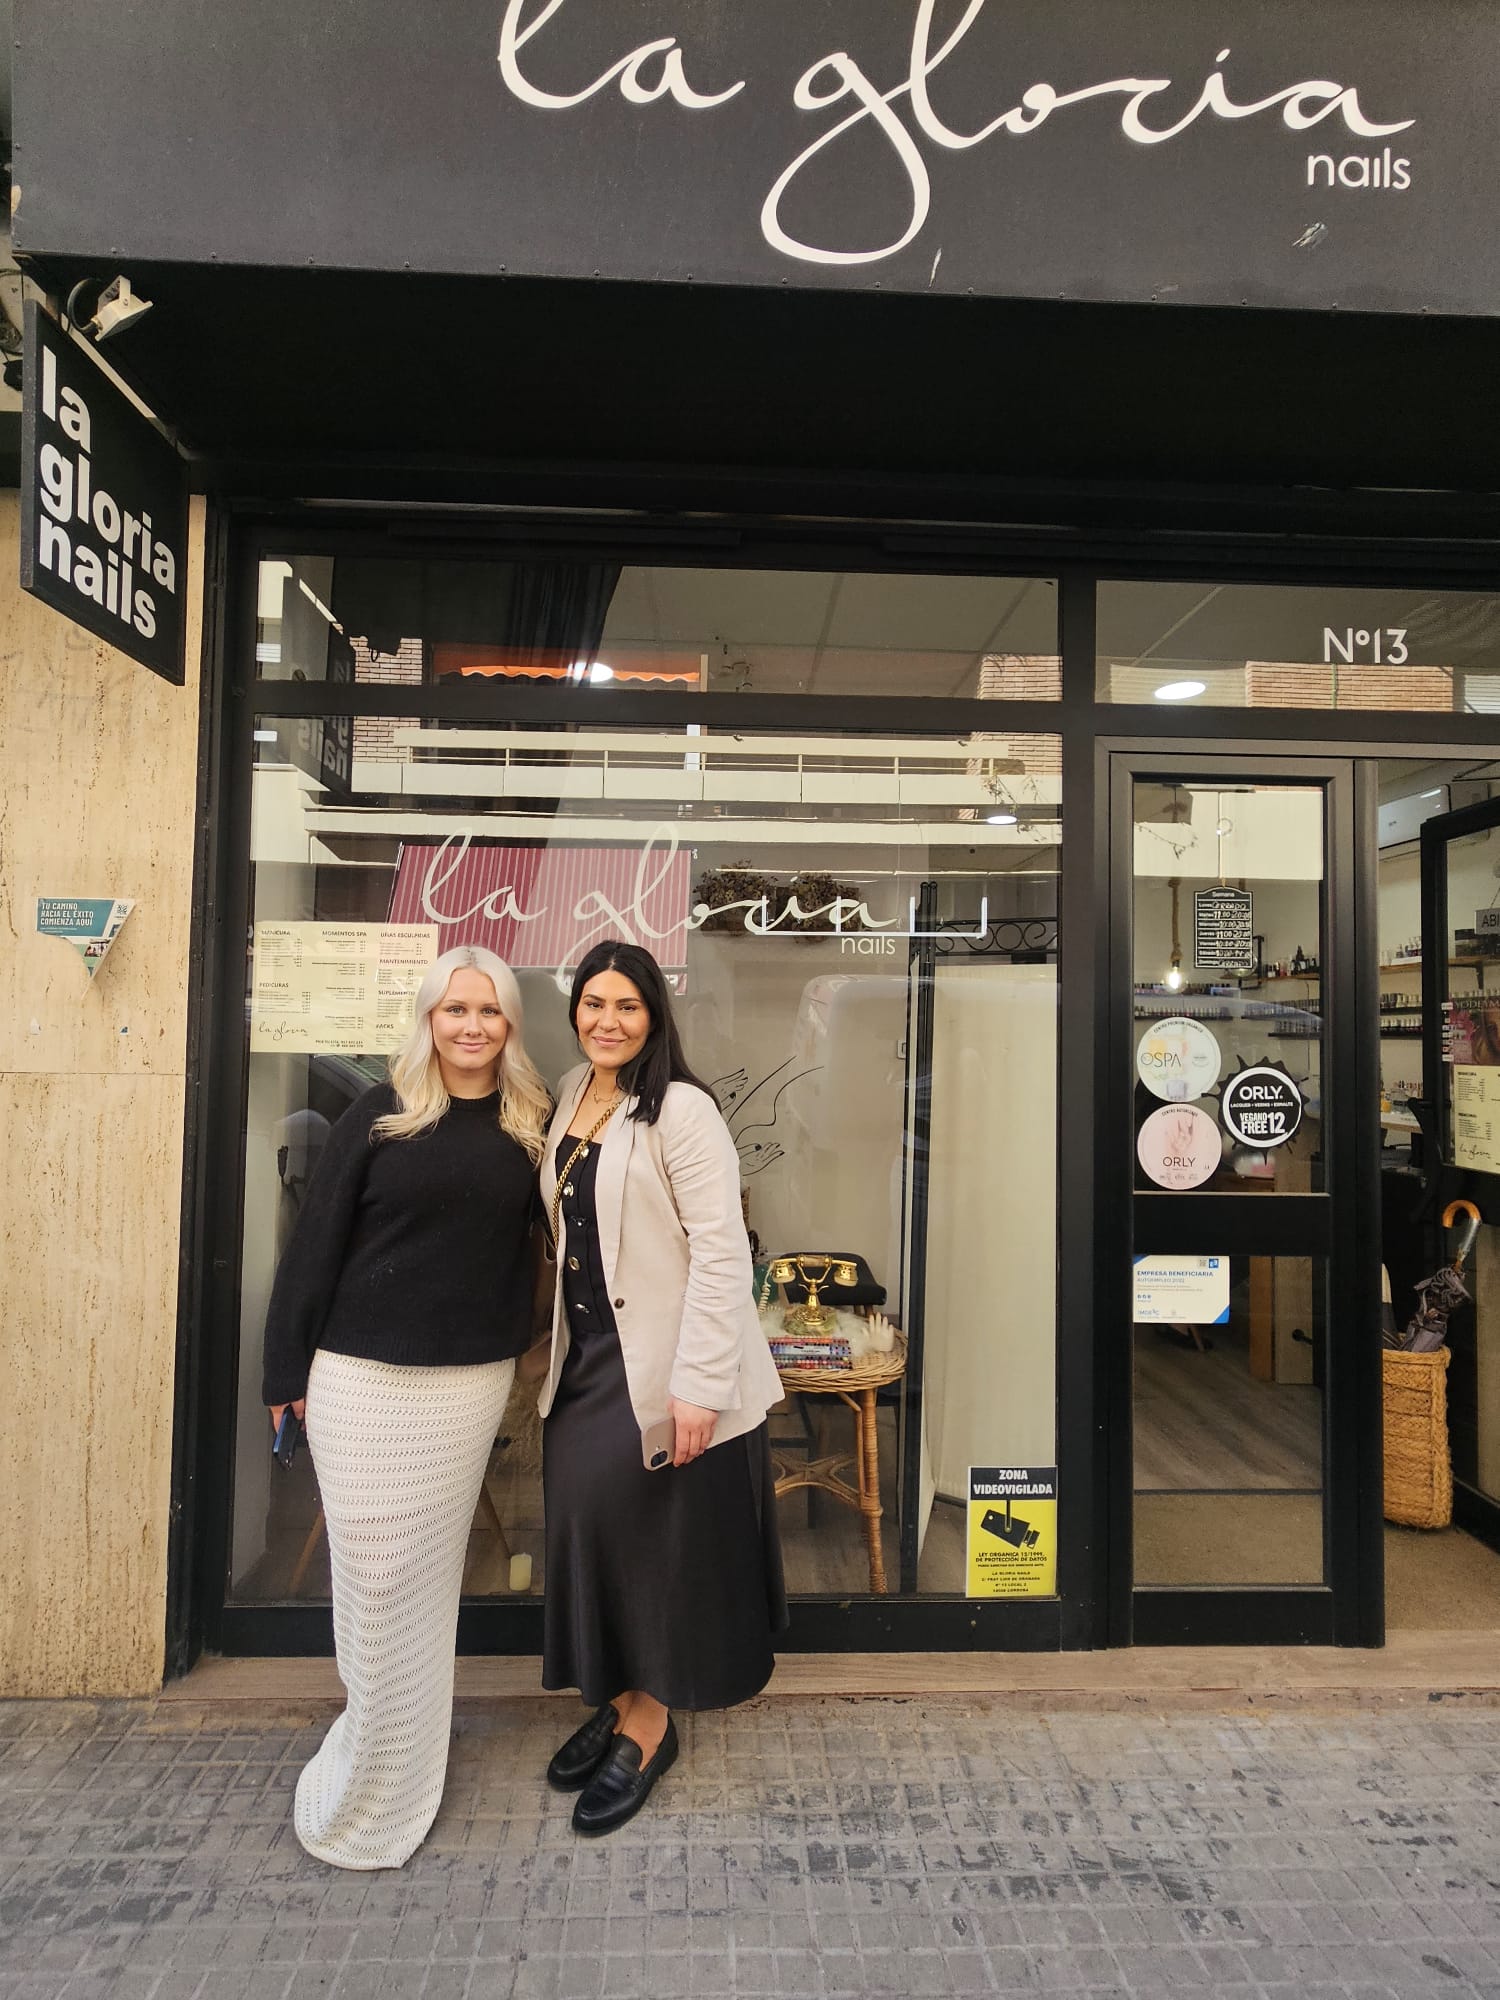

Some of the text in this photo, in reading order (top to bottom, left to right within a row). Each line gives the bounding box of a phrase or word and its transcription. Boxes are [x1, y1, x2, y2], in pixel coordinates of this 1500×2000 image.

[498, 0, 1416, 264] la gloria
[1307, 147, 1412, 190] nails
[42, 345, 91, 454] la
[40, 443, 175, 594] gloria
[39, 514, 156, 639] nails
[41, 902, 78, 910] TU CAMINO
[420, 824, 899, 998] la gloria
[40, 910, 61, 918] HACIA
[40, 918, 74, 926] COMIENZA
[840, 933, 896, 956] nails
[379, 958, 429, 966] MANTENIMIENTO
[1240, 1112, 1268, 1122] VEGANO
[1241, 1111, 1286, 1135] FREE 12
[1162, 1156, 1196, 1168] ORLY
[1168, 1270, 1214, 1278] BENEFICIARIA
[998, 1469, 1028, 1481] ZONA
[973, 1483, 1053, 1495] VIDEOVIGILADA
